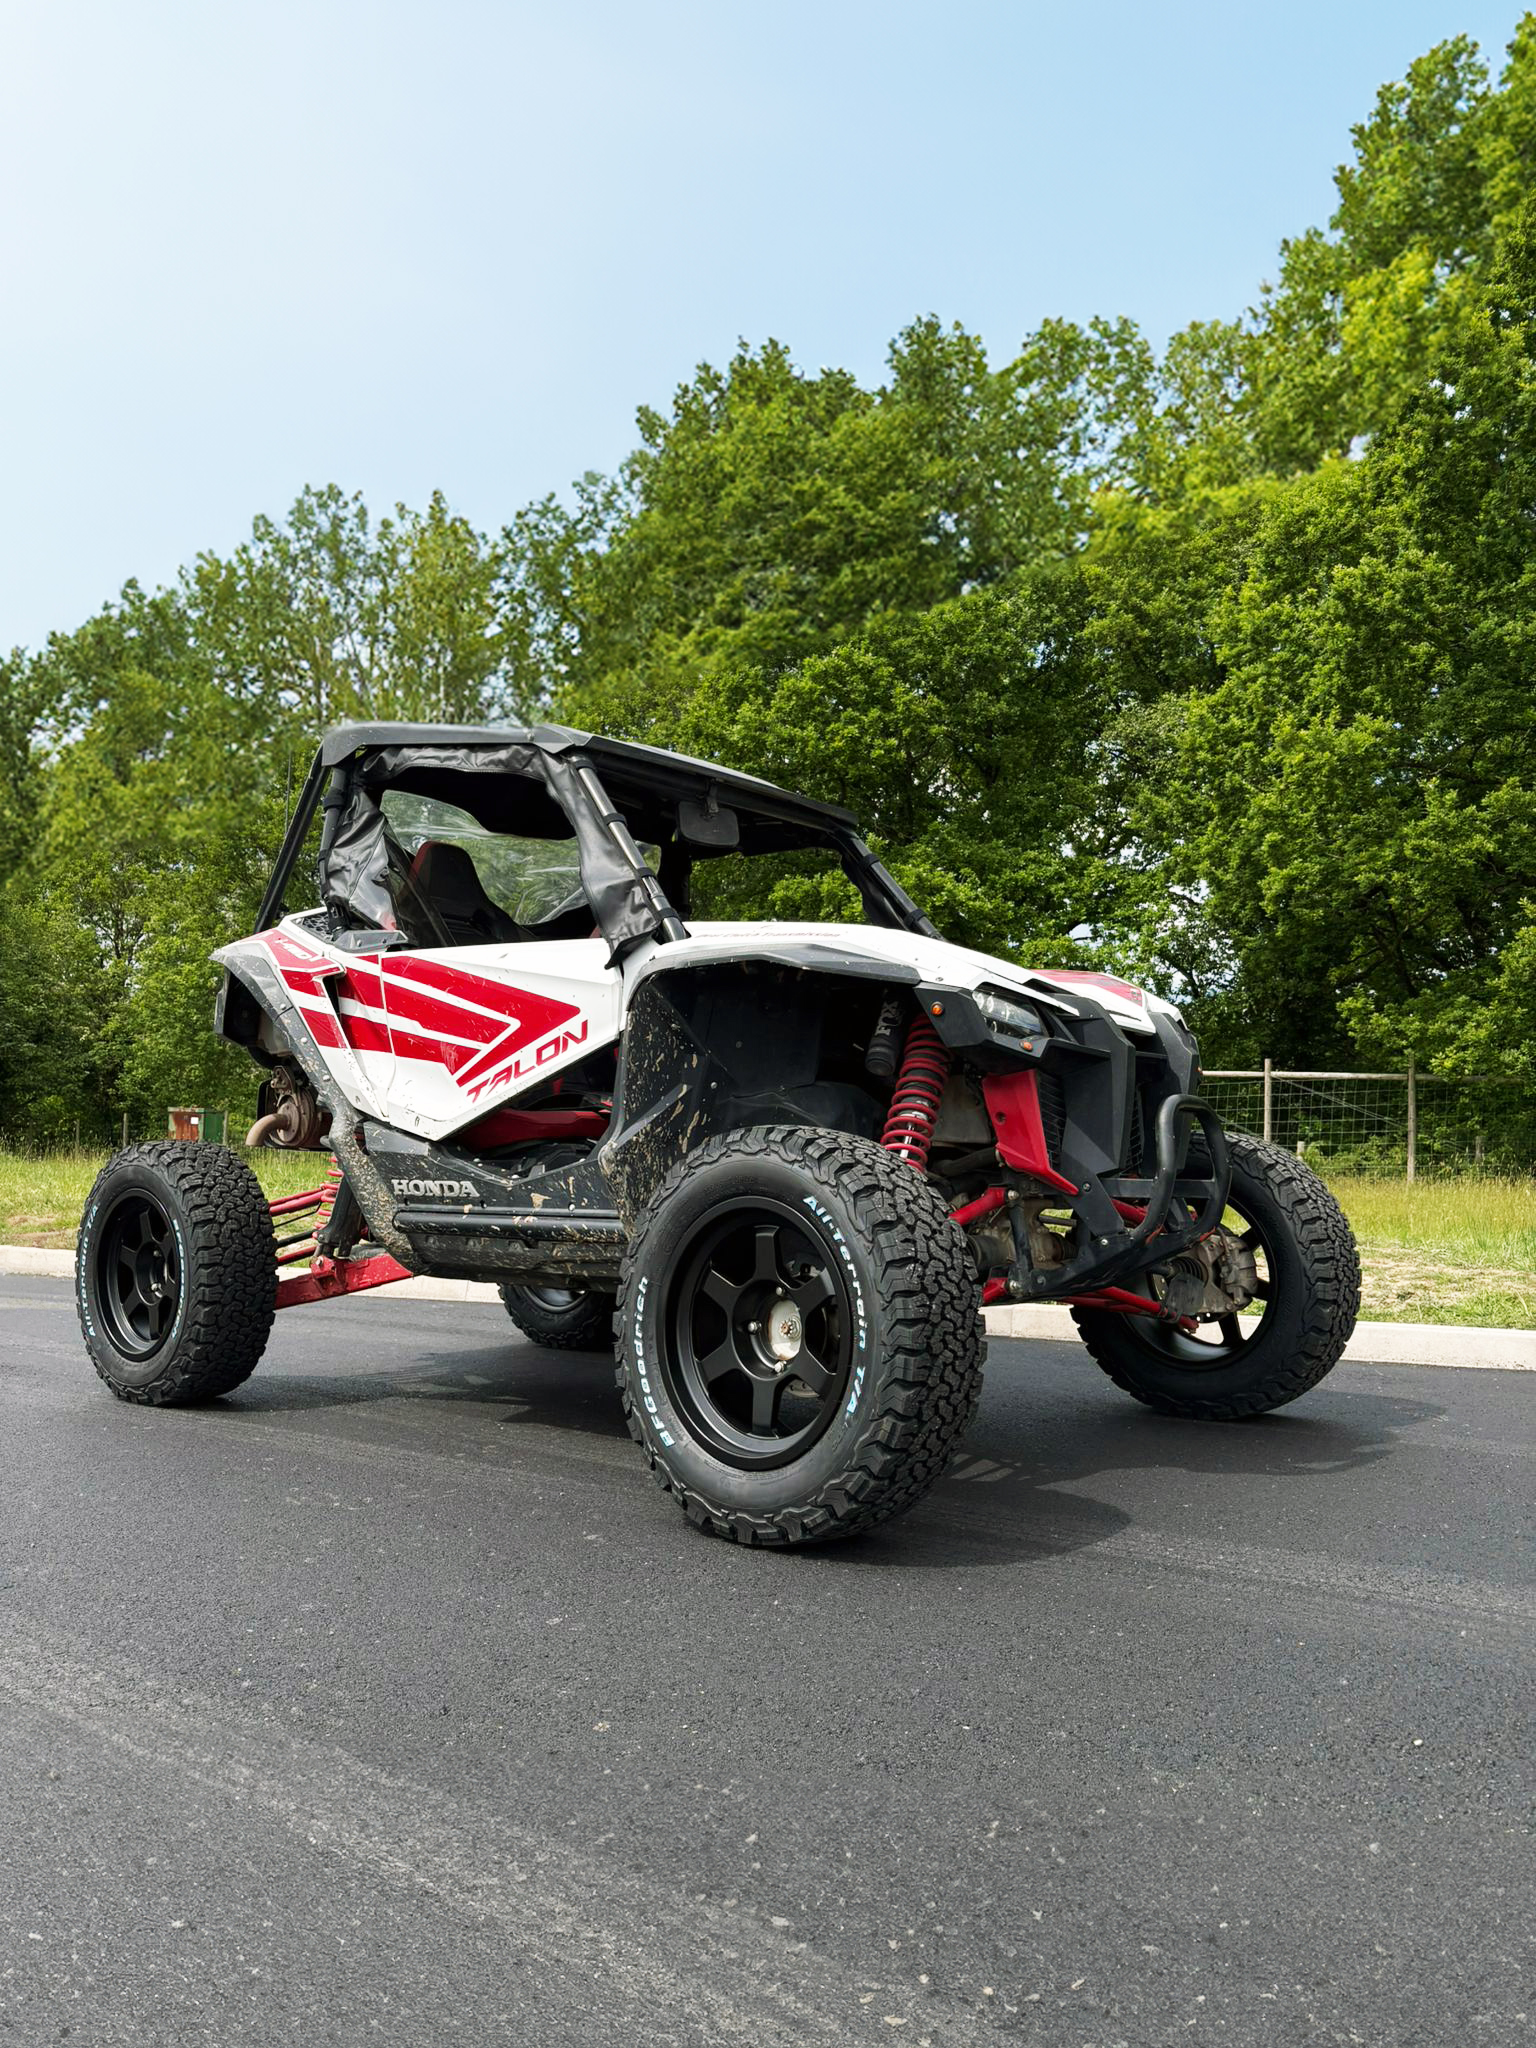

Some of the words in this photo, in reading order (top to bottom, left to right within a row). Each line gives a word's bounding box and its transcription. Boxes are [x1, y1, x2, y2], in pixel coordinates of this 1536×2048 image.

[466, 1019, 588, 1104] TALON
[391, 1179, 480, 1197] HONDA
[634, 1276, 676, 1447] BFGoodrich
[803, 1196, 866, 1349] All-Terrain
[846, 1366, 866, 1414] T/A
